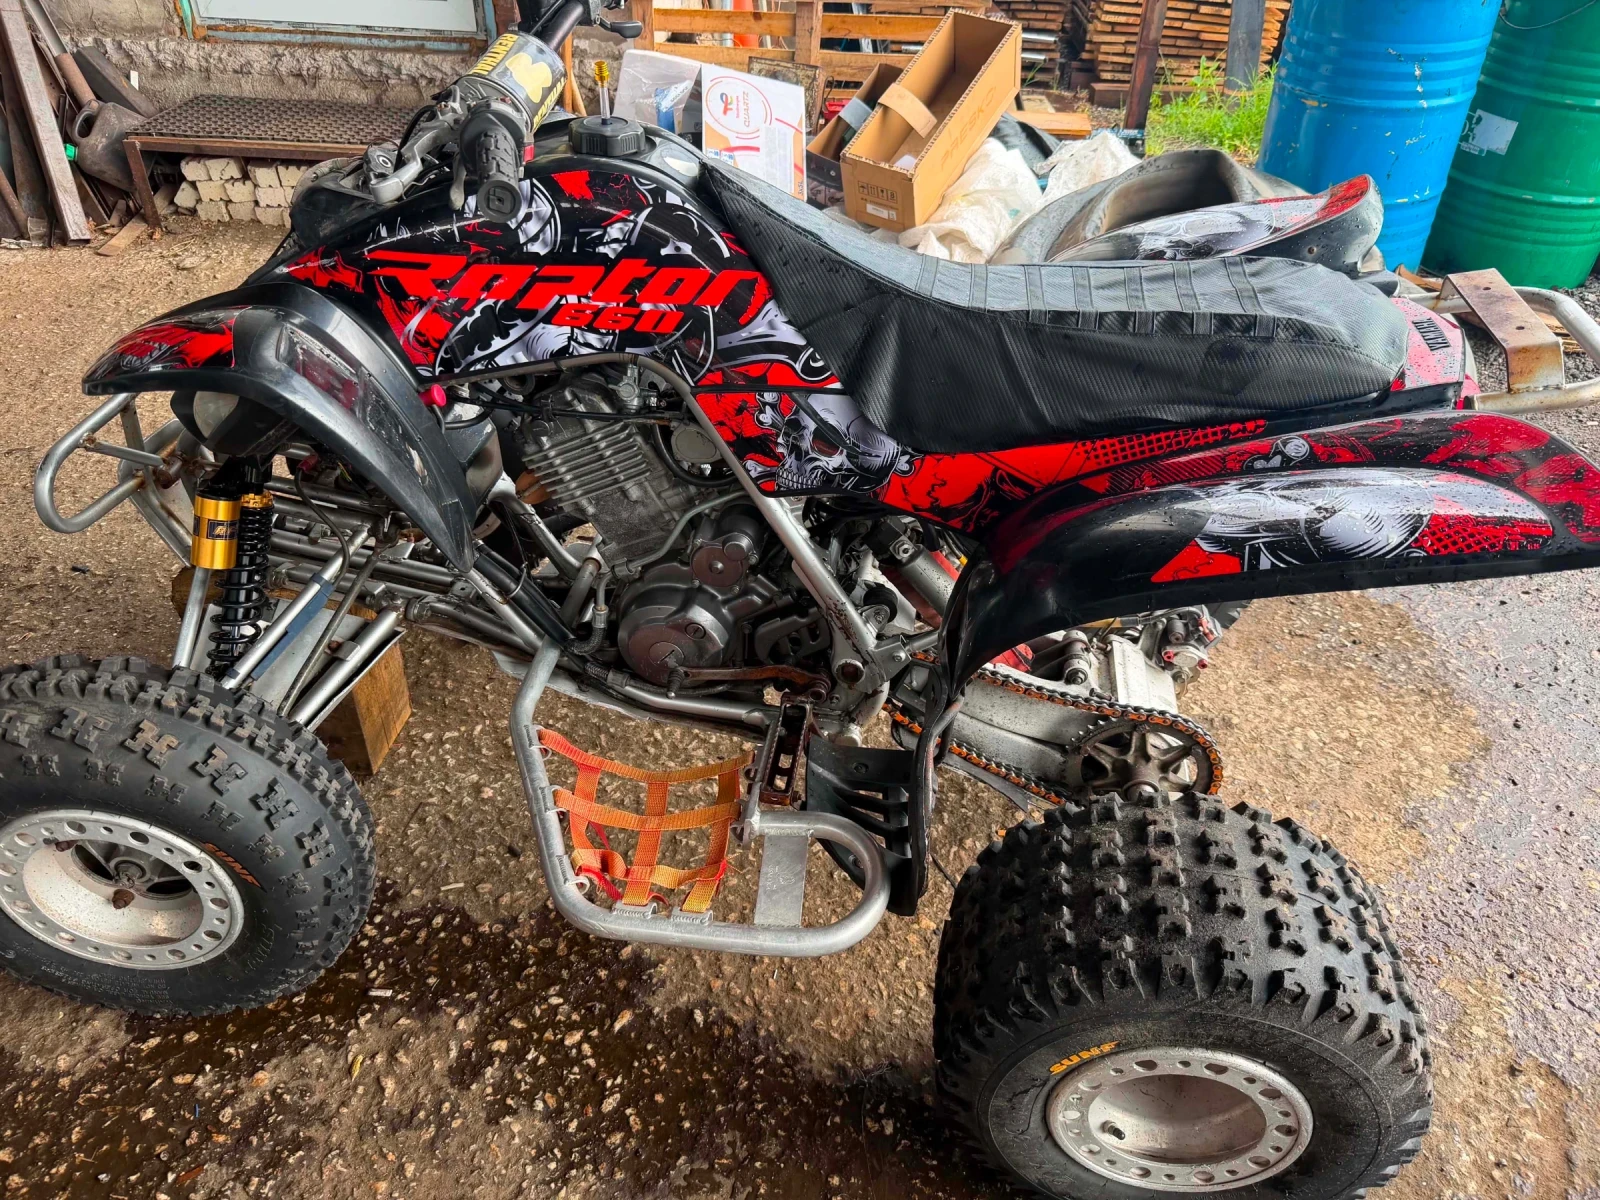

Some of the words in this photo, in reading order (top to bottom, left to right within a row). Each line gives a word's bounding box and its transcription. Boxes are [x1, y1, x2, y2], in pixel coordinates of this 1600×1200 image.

[467, 33, 520, 76] RENTHAL
[742, 90, 750, 128] QUARTZ
[551, 302, 685, 334] 660
[1411, 316, 1452, 352] YAMAHA
